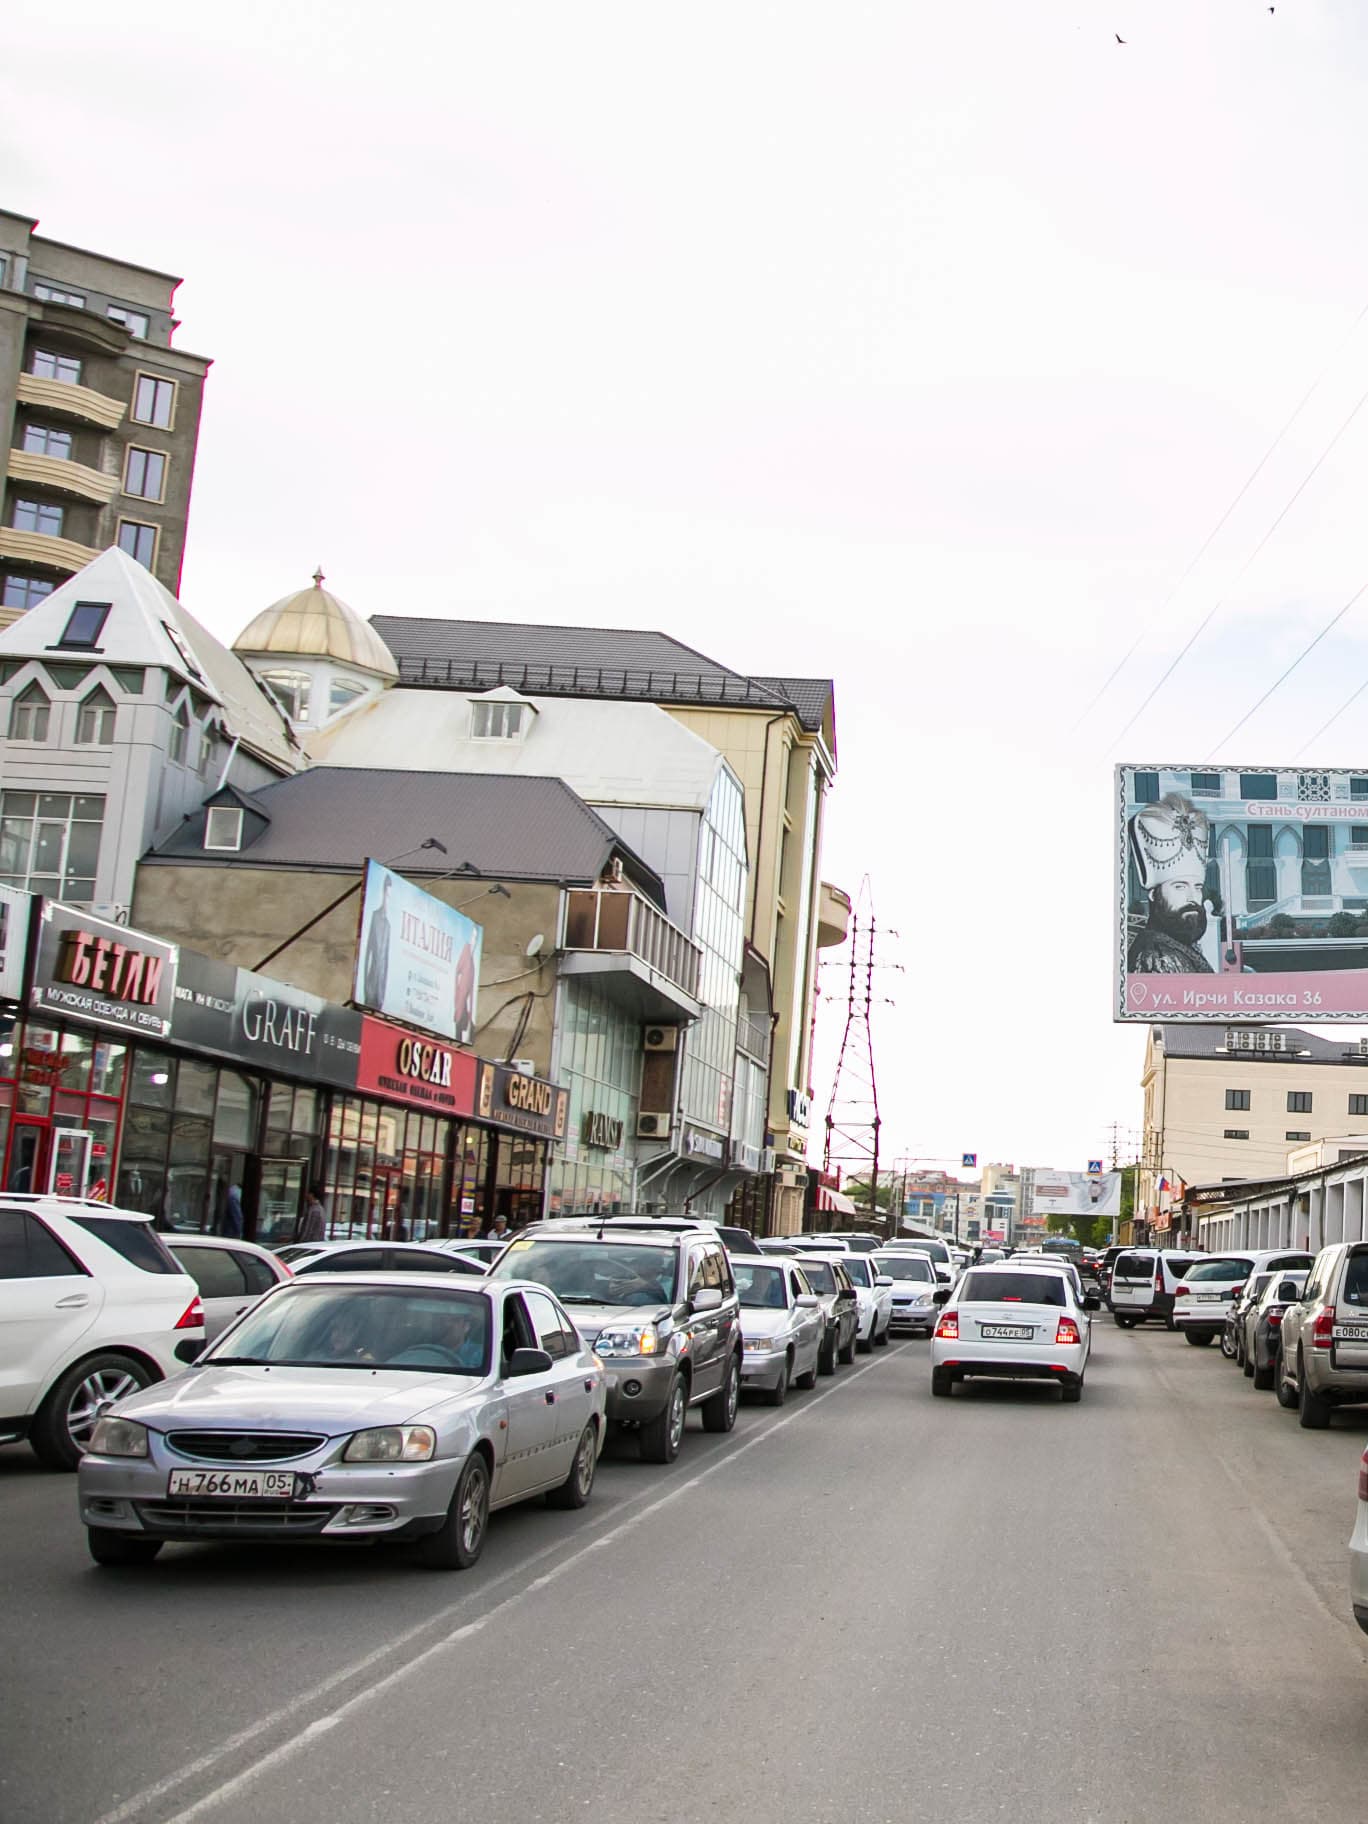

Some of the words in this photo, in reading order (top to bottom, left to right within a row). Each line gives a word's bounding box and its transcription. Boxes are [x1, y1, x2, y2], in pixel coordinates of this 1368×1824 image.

[1247, 803, 1292, 817] Стань
[1296, 805, 1368, 820] султаном
[67, 930, 163, 1005] БЕТЛИ
[47, 987, 92, 1010] МУЖСКАЯ
[1151, 992, 1177, 1009] ул.
[1183, 991, 1229, 1009] Ирчи
[1233, 991, 1297, 1006] Казака
[1302, 991, 1322, 1006] 36
[242, 988, 319, 1055] GRAFF
[398, 1038, 453, 1087] OSCAR
[507, 1073, 552, 1116] GRAND
[177, 1473, 259, 1494] Н766МА
[266, 1474, 287, 1489] 05
